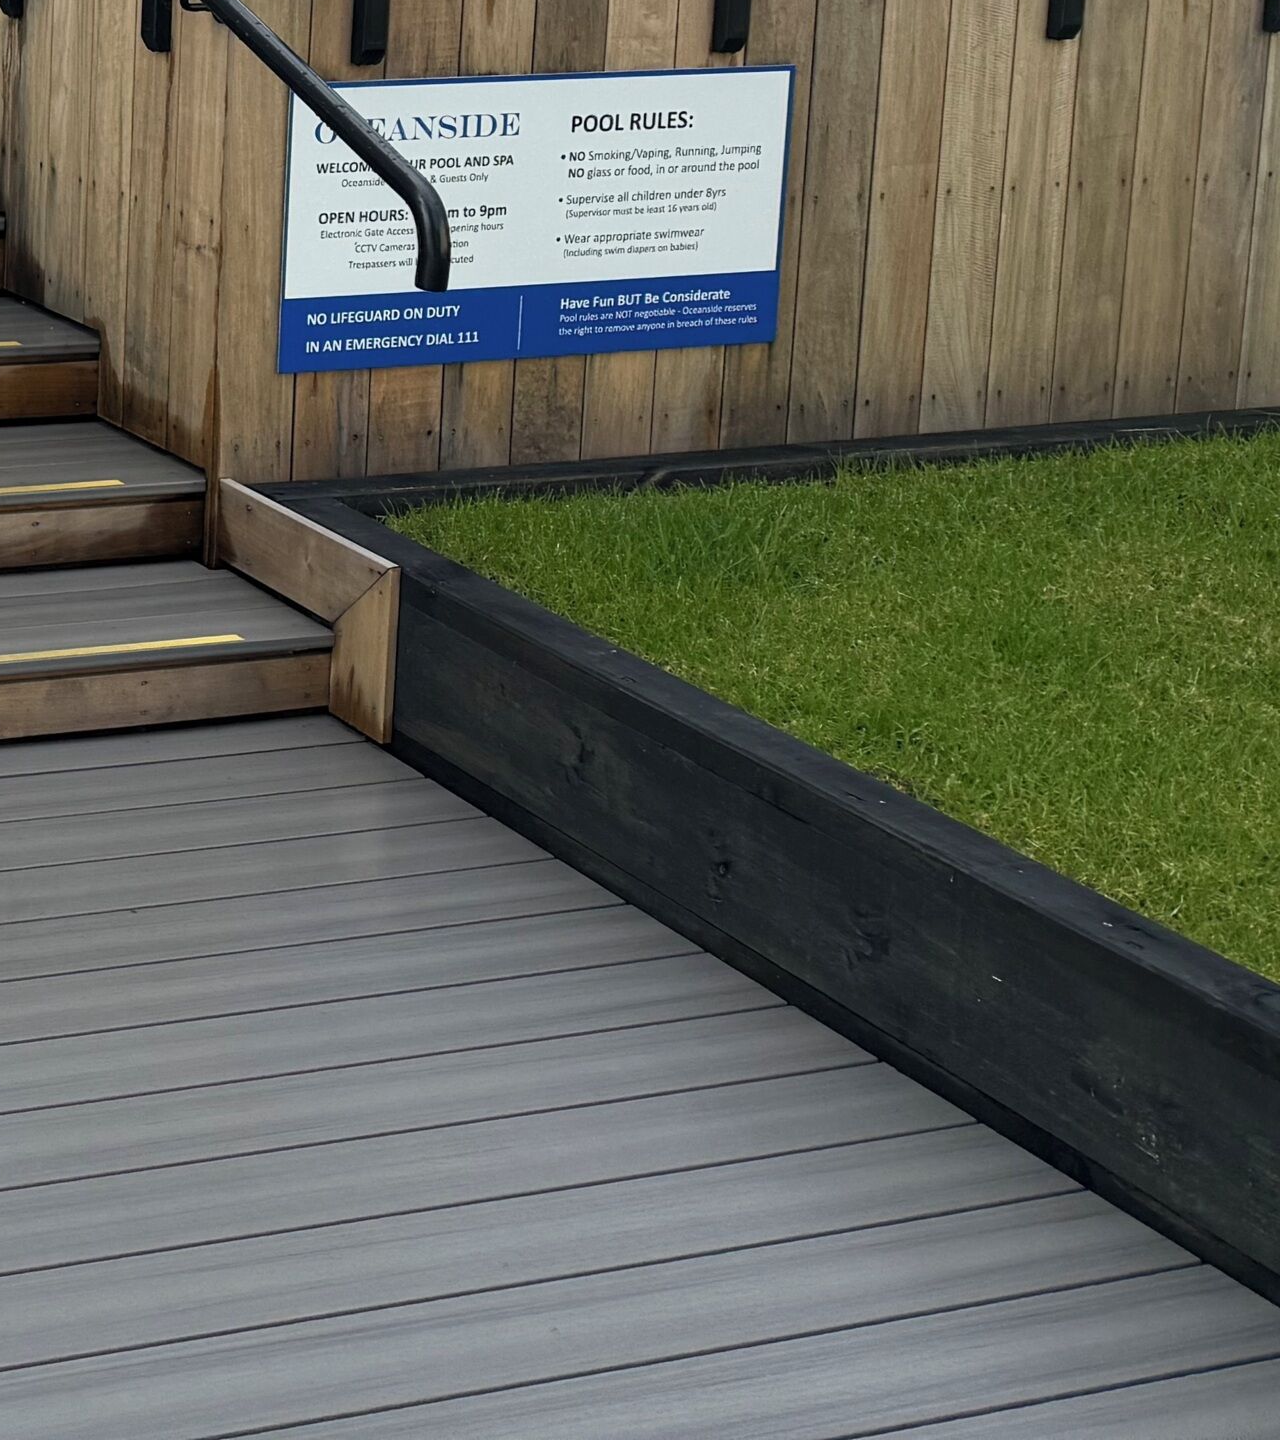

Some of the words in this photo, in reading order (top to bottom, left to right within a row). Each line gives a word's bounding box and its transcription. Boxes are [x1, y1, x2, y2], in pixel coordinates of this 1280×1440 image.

[314, 112, 520, 144] OEANSIDE
[571, 114, 624, 132] POOL
[630, 110, 694, 130] RULES:
[569, 151, 586, 161] NO
[588, 148, 672, 161] Smoking/Vaping,
[675, 146, 718, 158] Running,
[720, 144, 762, 155] Jumping
[316, 162, 372, 174] WELCOM
[410, 159, 426, 169] UR
[430, 158, 460, 169] POOL
[464, 156, 490, 167] AND
[493, 154, 514, 166] SPA
[568, 168, 584, 178] NO
[587, 167, 611, 180] glass
[614, 168, 625, 176] or
[628, 164, 653, 176] food,
[656, 164, 665, 174] in
[681, 162, 716, 172] around
[719, 161, 735, 171] the
[738, 160, 760, 172] pool
[430, 175, 437, 183] &
[440, 174, 467, 183] Guests
[470, 172, 489, 182] Only
[566, 193, 614, 206] Supervise
[618, 192, 629, 202] all
[632, 190, 672, 202] children
[674, 189, 703, 200] under
[706, 188, 726, 199] 8yrs
[318, 212, 355, 224] OPEN
[359, 209, 408, 222] HOURS:
[463, 206, 476, 217] to
[480, 205, 507, 219] 9pm
[566, 208, 610, 219] (Supervisor
[613, 207, 632, 216] must
[634, 205, 644, 214] be
[646, 205, 665, 214] least
[668, 204, 678, 212] 16
[679, 204, 700, 214] years
[702, 202, 717, 212] old)
[320, 228, 362, 239] Electronic
[364, 228, 384, 236] Gate
[386, 227, 414, 235] Access
[564, 234, 590, 244] Wear
[593, 231, 651, 244] appropriate
[654, 228, 704, 239] swimwear
[355, 244, 377, 253] CCTV
[380, 243, 415, 252] Cameras
[563, 247, 602, 258] (Including
[604, 246, 625, 255] swim
[627, 244, 656, 255] diapers
[658, 244, 668, 252] on
[670, 241, 698, 252] babies)
[349, 259, 396, 269] Trespassers
[399, 258, 413, 266] will
[560, 298, 590, 310] Have
[593, 296, 614, 307] Fun
[617, 294, 641, 306] BUT
[645, 293, 659, 304] Be
[662, 289, 731, 303] Considerate
[307, 314, 327, 326] NO
[330, 309, 400, 324] LIFEGUARD
[403, 308, 423, 320] ON
[427, 305, 460, 319] DUTY
[560, 314, 577, 322] Pool
[579, 313, 598, 321] rules
[615, 310, 633, 319] NOT
[634, 308, 675, 319] negotiable
[682, 305, 722, 315] Oceanside
[724, 303, 757, 312] reserves
[559, 327, 573, 336] the
[574, 326, 593, 336] right
[604, 325, 635, 333] remove
[637, 322, 665, 332] anyone
[667, 320, 675, 328] in
[677, 318, 703, 328] breach
[705, 317, 713, 325] of
[714, 316, 736, 325] these
[738, 315, 757, 324] rules
[306, 341, 320, 353] IN
[322, 340, 342, 352] AN
[346, 335, 423, 351] EMERGENCY
[426, 333, 454, 346] DIAL
[457, 332, 479, 343] 111
